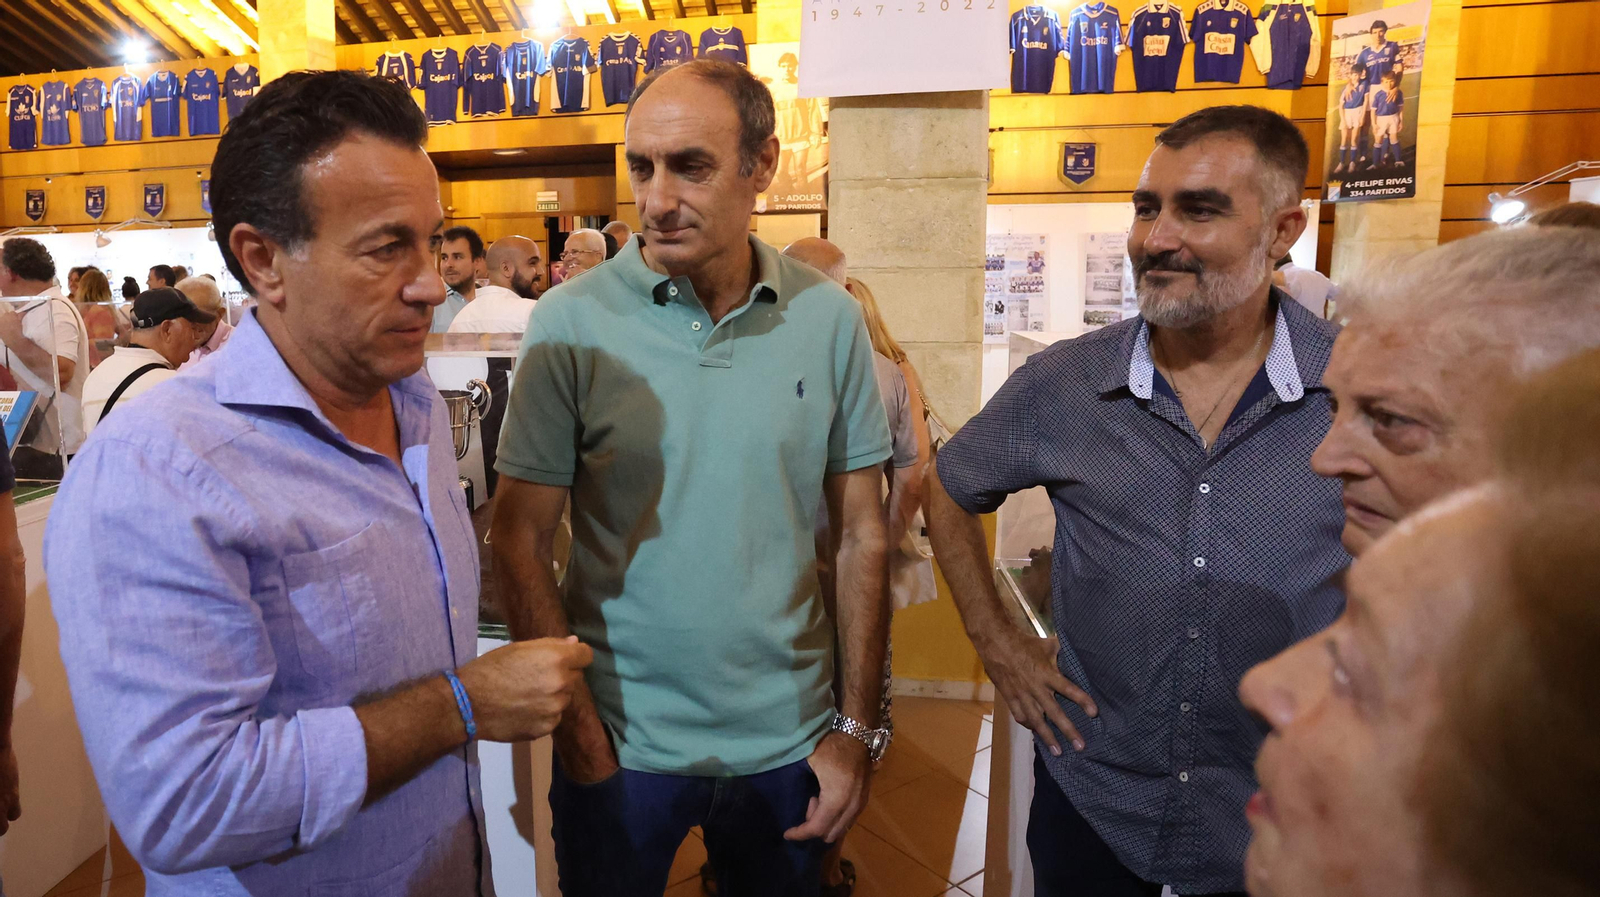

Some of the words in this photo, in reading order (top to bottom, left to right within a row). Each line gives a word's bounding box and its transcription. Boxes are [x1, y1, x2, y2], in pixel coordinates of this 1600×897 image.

[1345, 179, 1384, 189] 4-FELIPE
[1385, 176, 1413, 186] RIVAS
[1365, 186, 1407, 196] PARTIDOS
[773, 194, 779, 202] 5
[785, 193, 823, 202] ADOLFO
